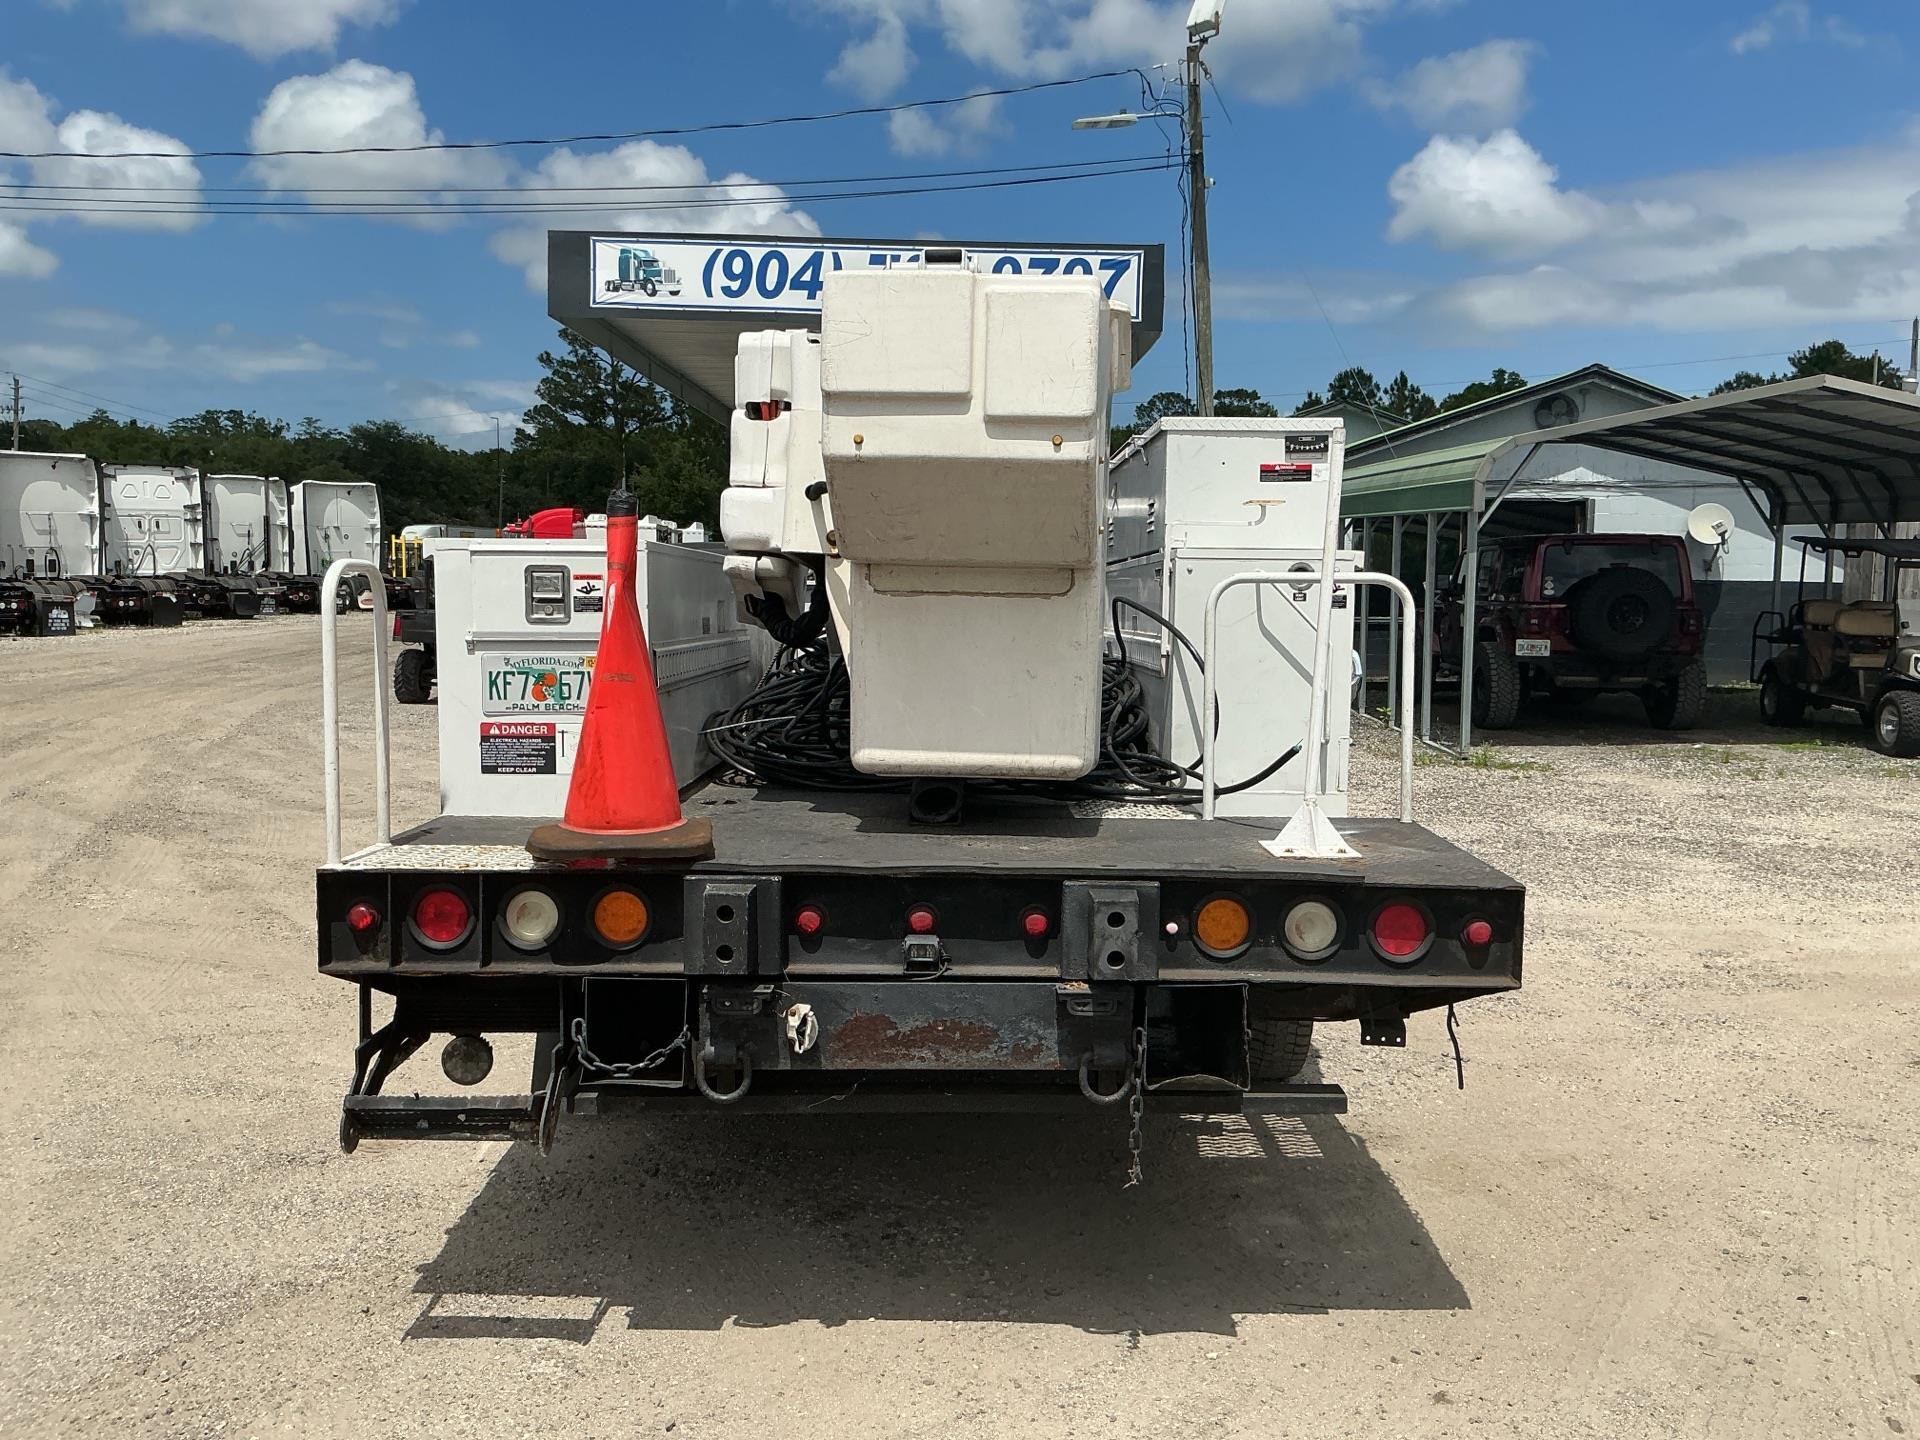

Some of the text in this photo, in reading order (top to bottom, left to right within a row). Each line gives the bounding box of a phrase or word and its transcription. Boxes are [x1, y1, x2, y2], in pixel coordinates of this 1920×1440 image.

[488, 671, 530, 701] KF7
[512, 703, 579, 711] PALM BEACH
[501, 725, 548, 734] DANGER
